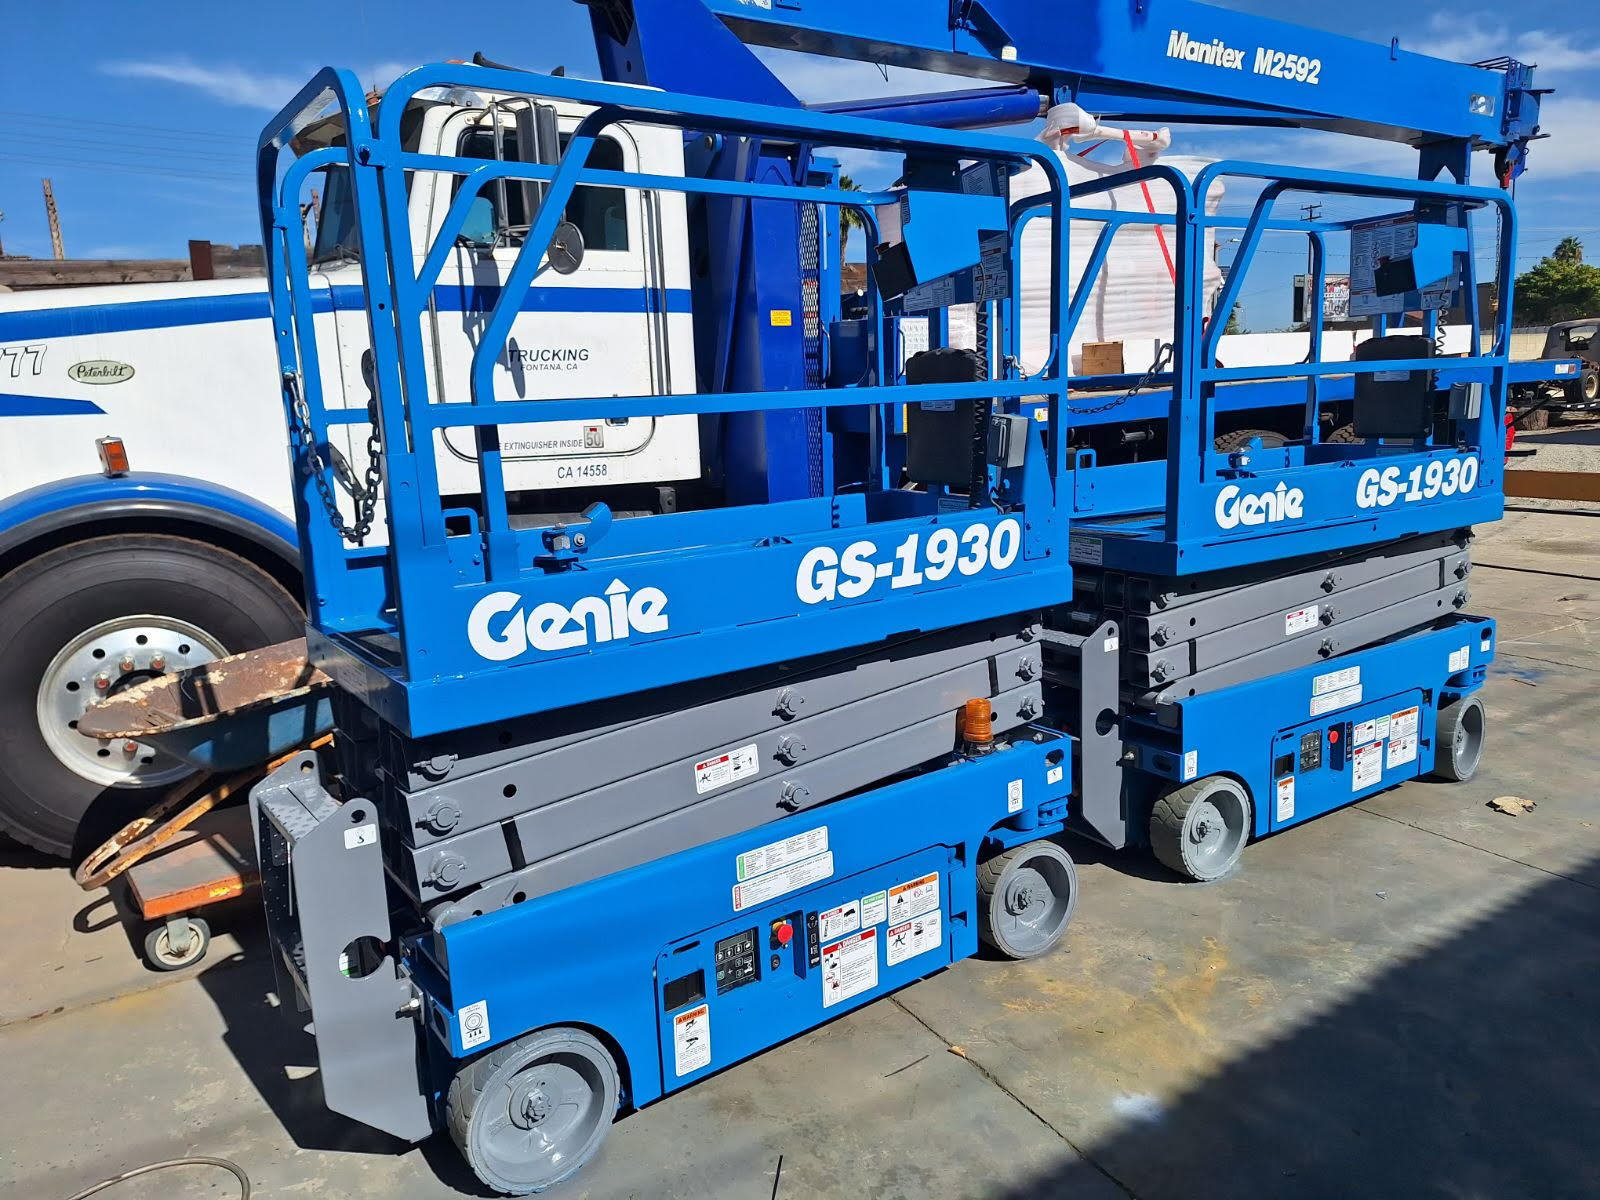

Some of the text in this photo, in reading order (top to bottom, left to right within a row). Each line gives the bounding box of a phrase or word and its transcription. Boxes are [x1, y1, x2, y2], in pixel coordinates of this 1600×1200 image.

[1166, 30, 1322, 85] Manitex M2592
[0, 344, 47, 378] 77
[508, 348, 590, 362] TRUCKING
[76, 366, 128, 379] Peterbilt
[520, 362, 578, 372] FONTANA, CA
[504, 441, 558, 451] EXTINGUISHER
[559, 439, 583, 449] INSIDE
[586, 433, 601, 447] 50
[557, 464, 608, 479] CA 14558
[1215, 456, 1479, 530] Genie GS-1930
[467, 518, 1021, 661] Genie GS-1930
[893, 923, 911, 935] DANGER
[682, 1008, 706, 1021] WARNING
